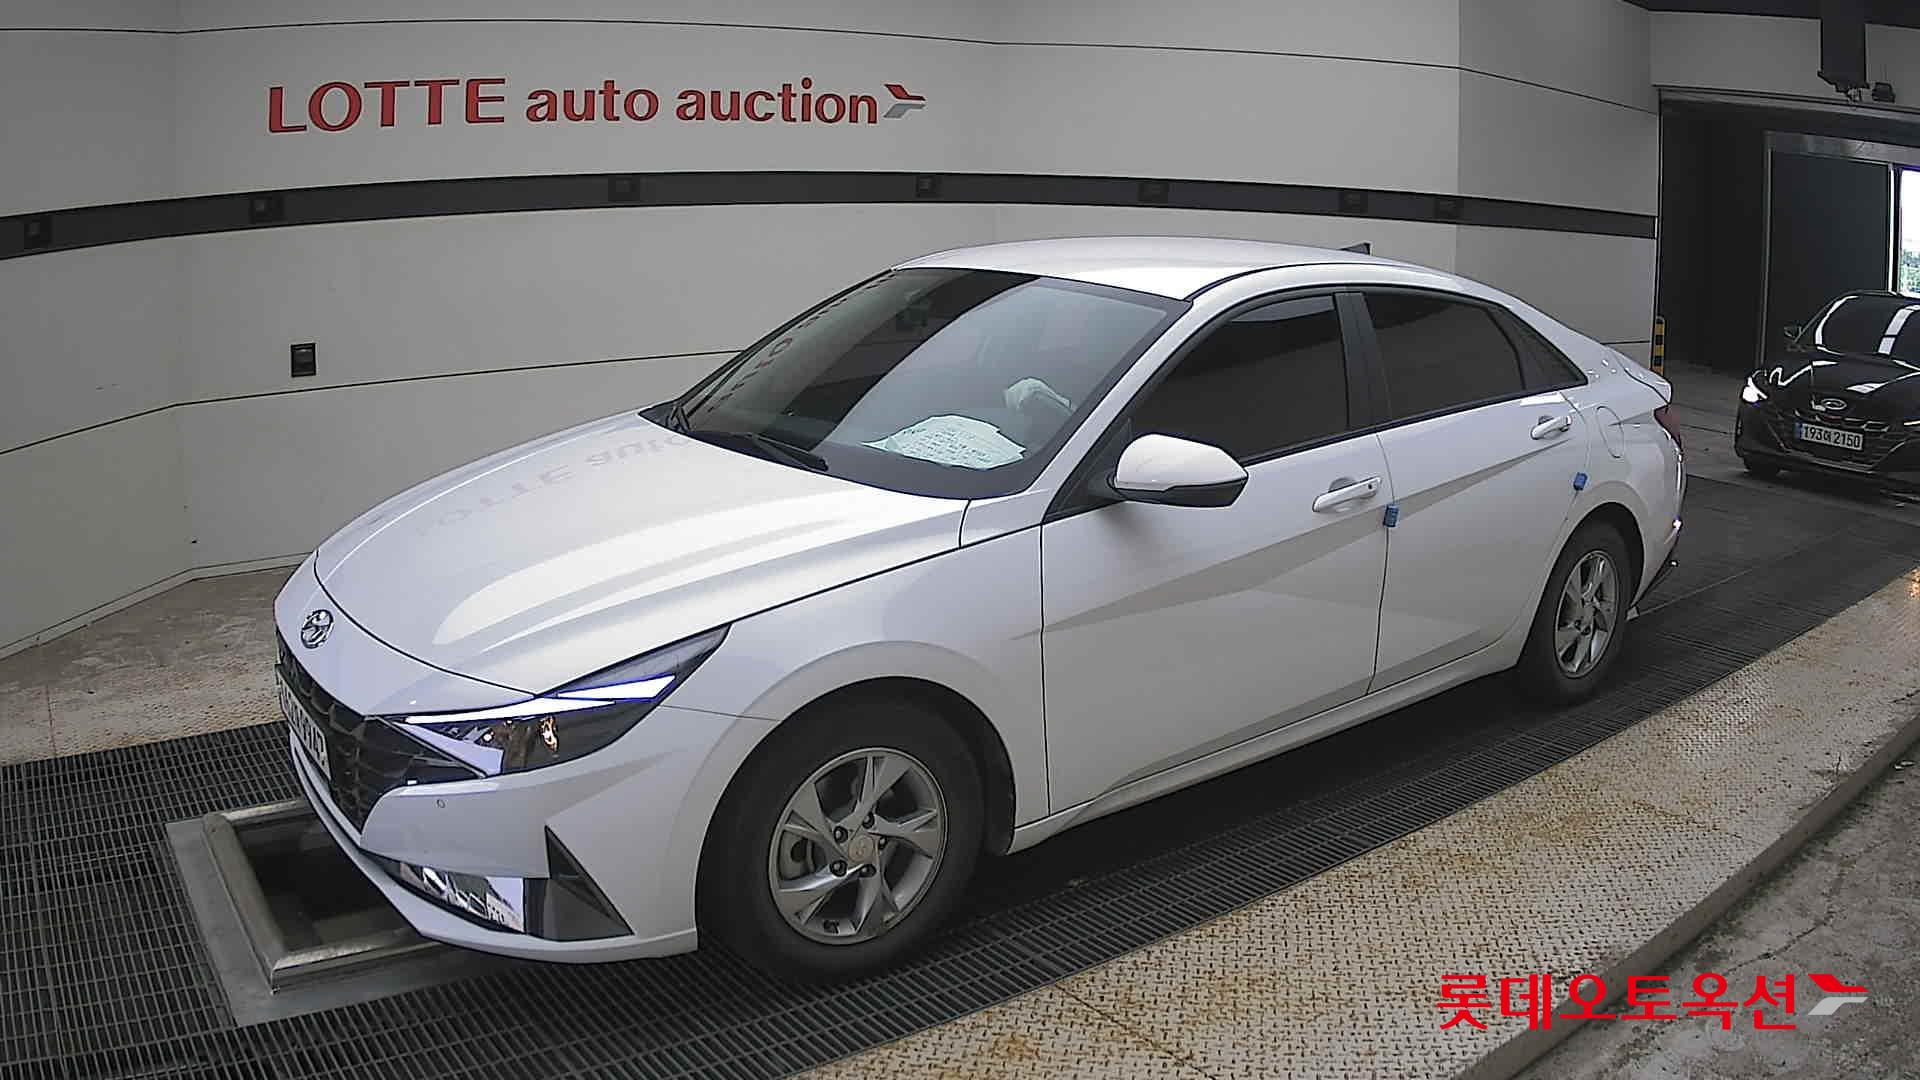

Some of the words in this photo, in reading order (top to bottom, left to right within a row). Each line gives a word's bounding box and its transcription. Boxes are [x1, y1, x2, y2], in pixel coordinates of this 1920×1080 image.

[268, 78, 505, 133] LOTTE
[526, 79, 659, 122] auto
[676, 77, 877, 124] auction
